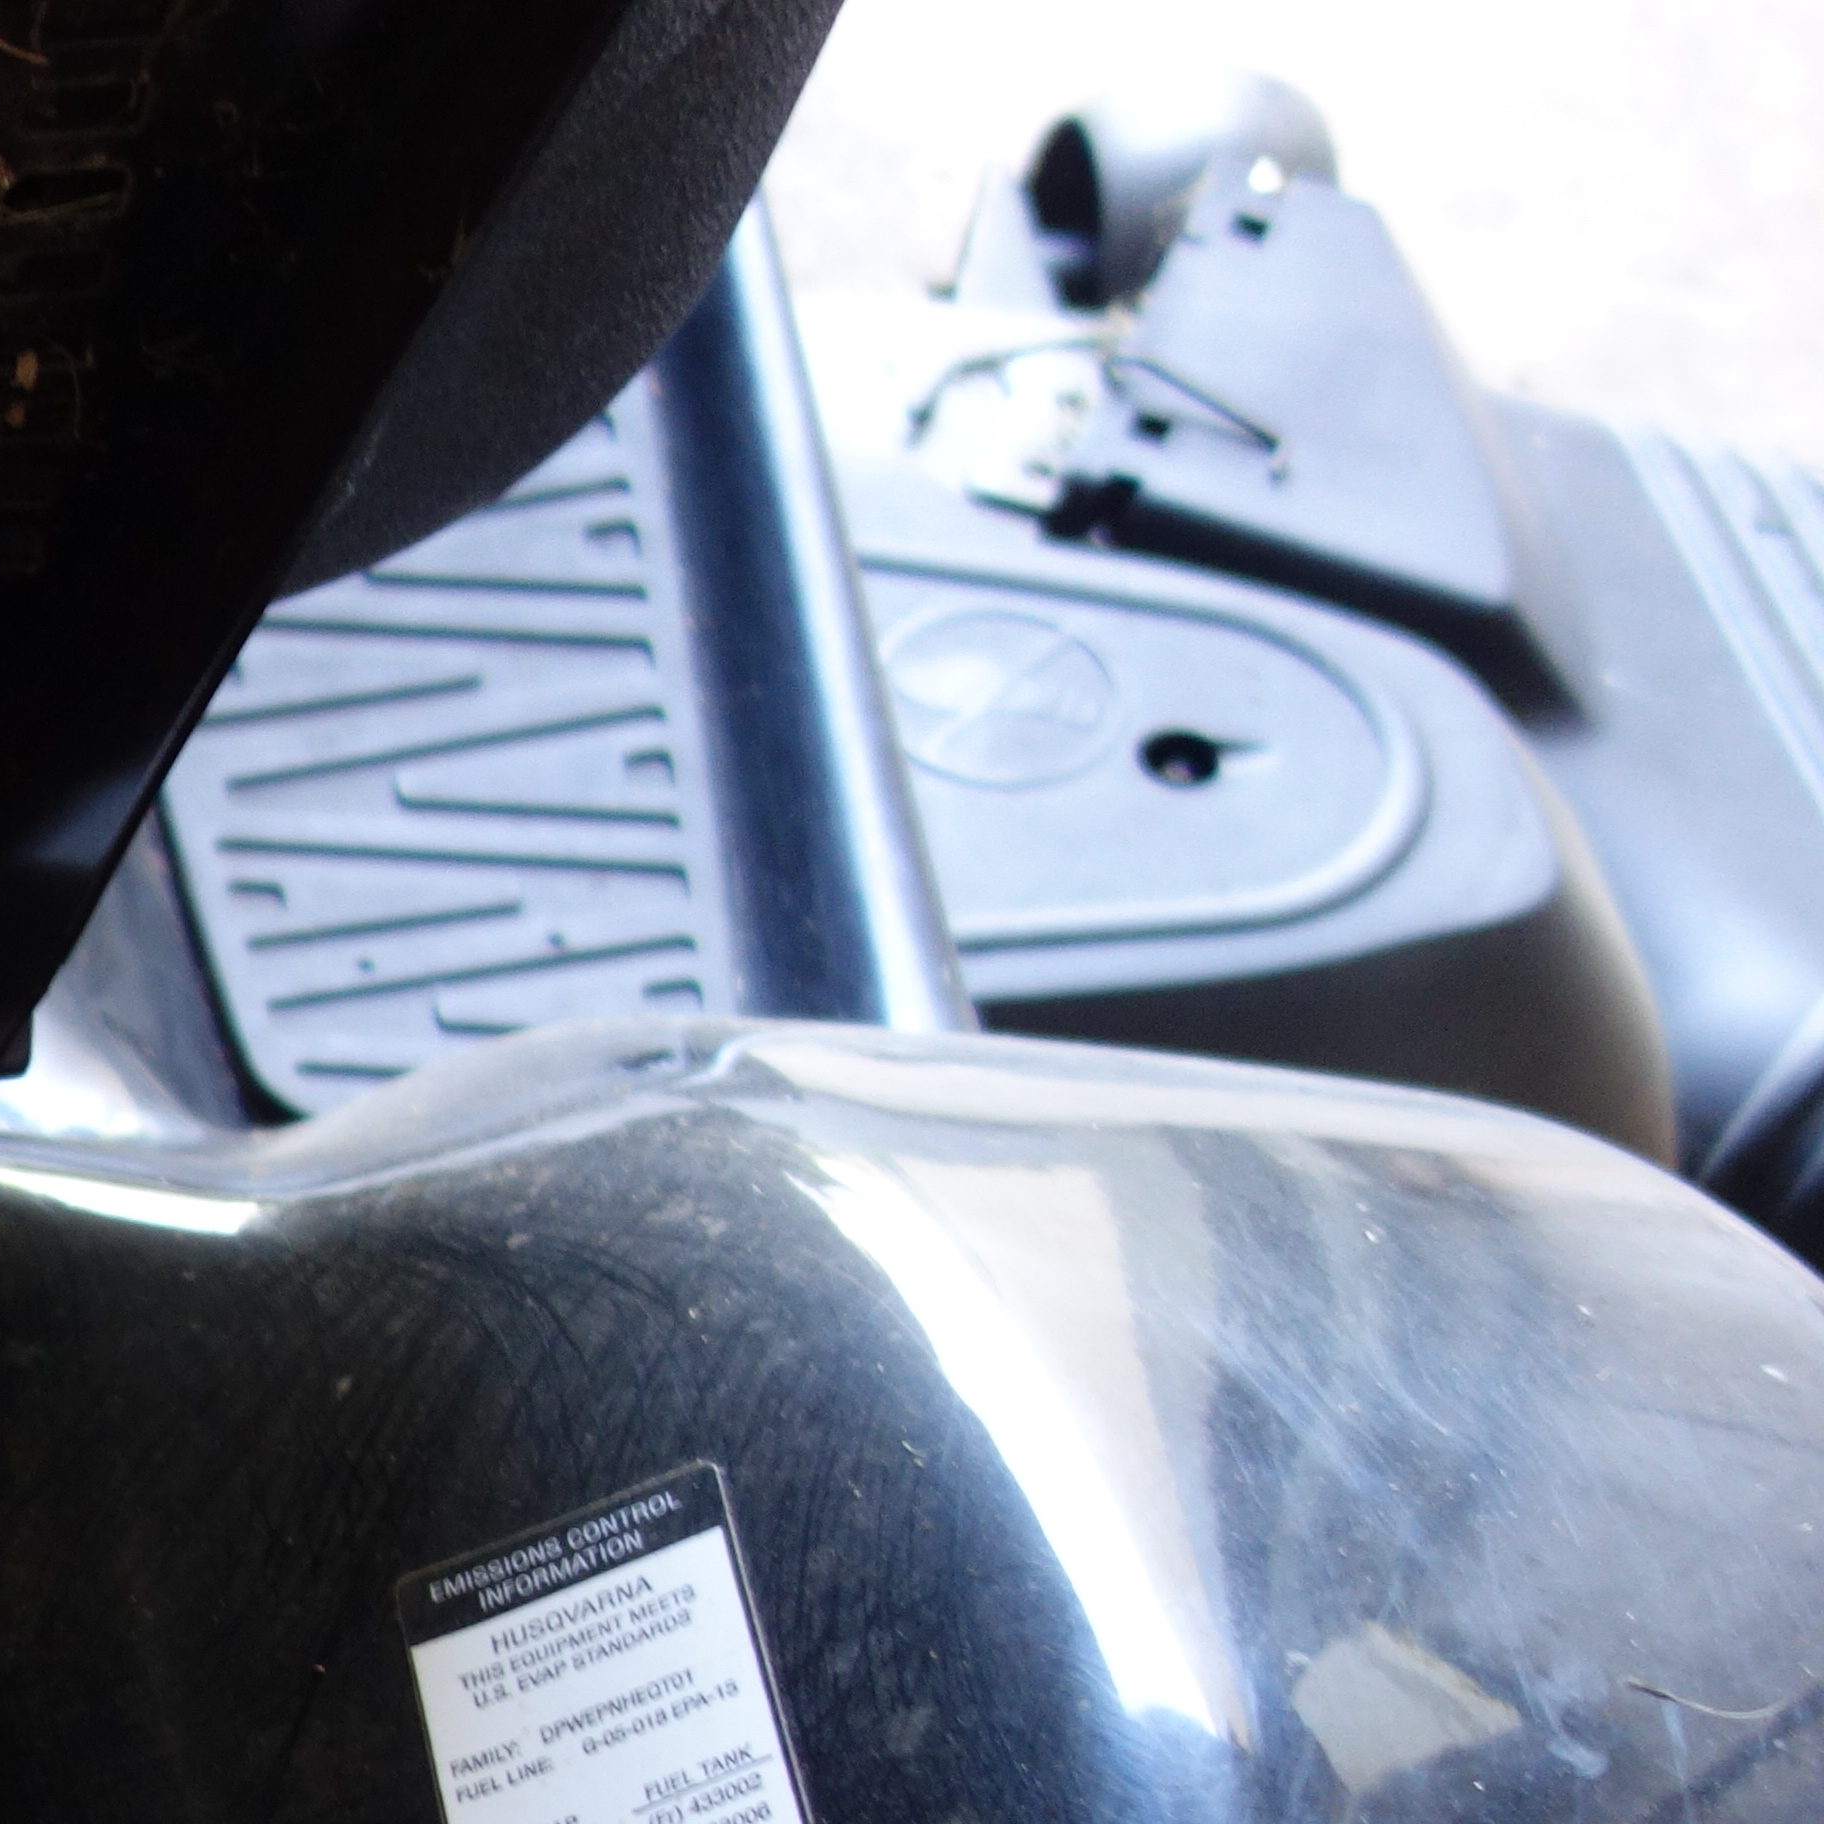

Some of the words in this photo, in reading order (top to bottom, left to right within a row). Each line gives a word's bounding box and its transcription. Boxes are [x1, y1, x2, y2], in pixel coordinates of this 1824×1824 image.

[429, 1535, 563, 1603] EMISSIONS
[567, 1489, 680, 1550] CONTROL
[478, 1528, 644, 1610] INFORMATION
[459, 1661, 505, 1691] THIS
[508, 1614, 622, 1673] EQUIPMENT
[628, 1583, 696, 1625] MEETS
[489, 1574, 653, 1656] HUSQVARNA
[473, 1682, 510, 1710] U.S.
[516, 1659, 568, 1693] EVAP
[571, 1609, 691, 1671] STANDARDS
[455, 1775, 500, 1804] FUEL
[643, 1768, 693, 1801] FUEL
[701, 1746, 754, 1778] TANK
[688, 1772, 763, 1815] 433002
